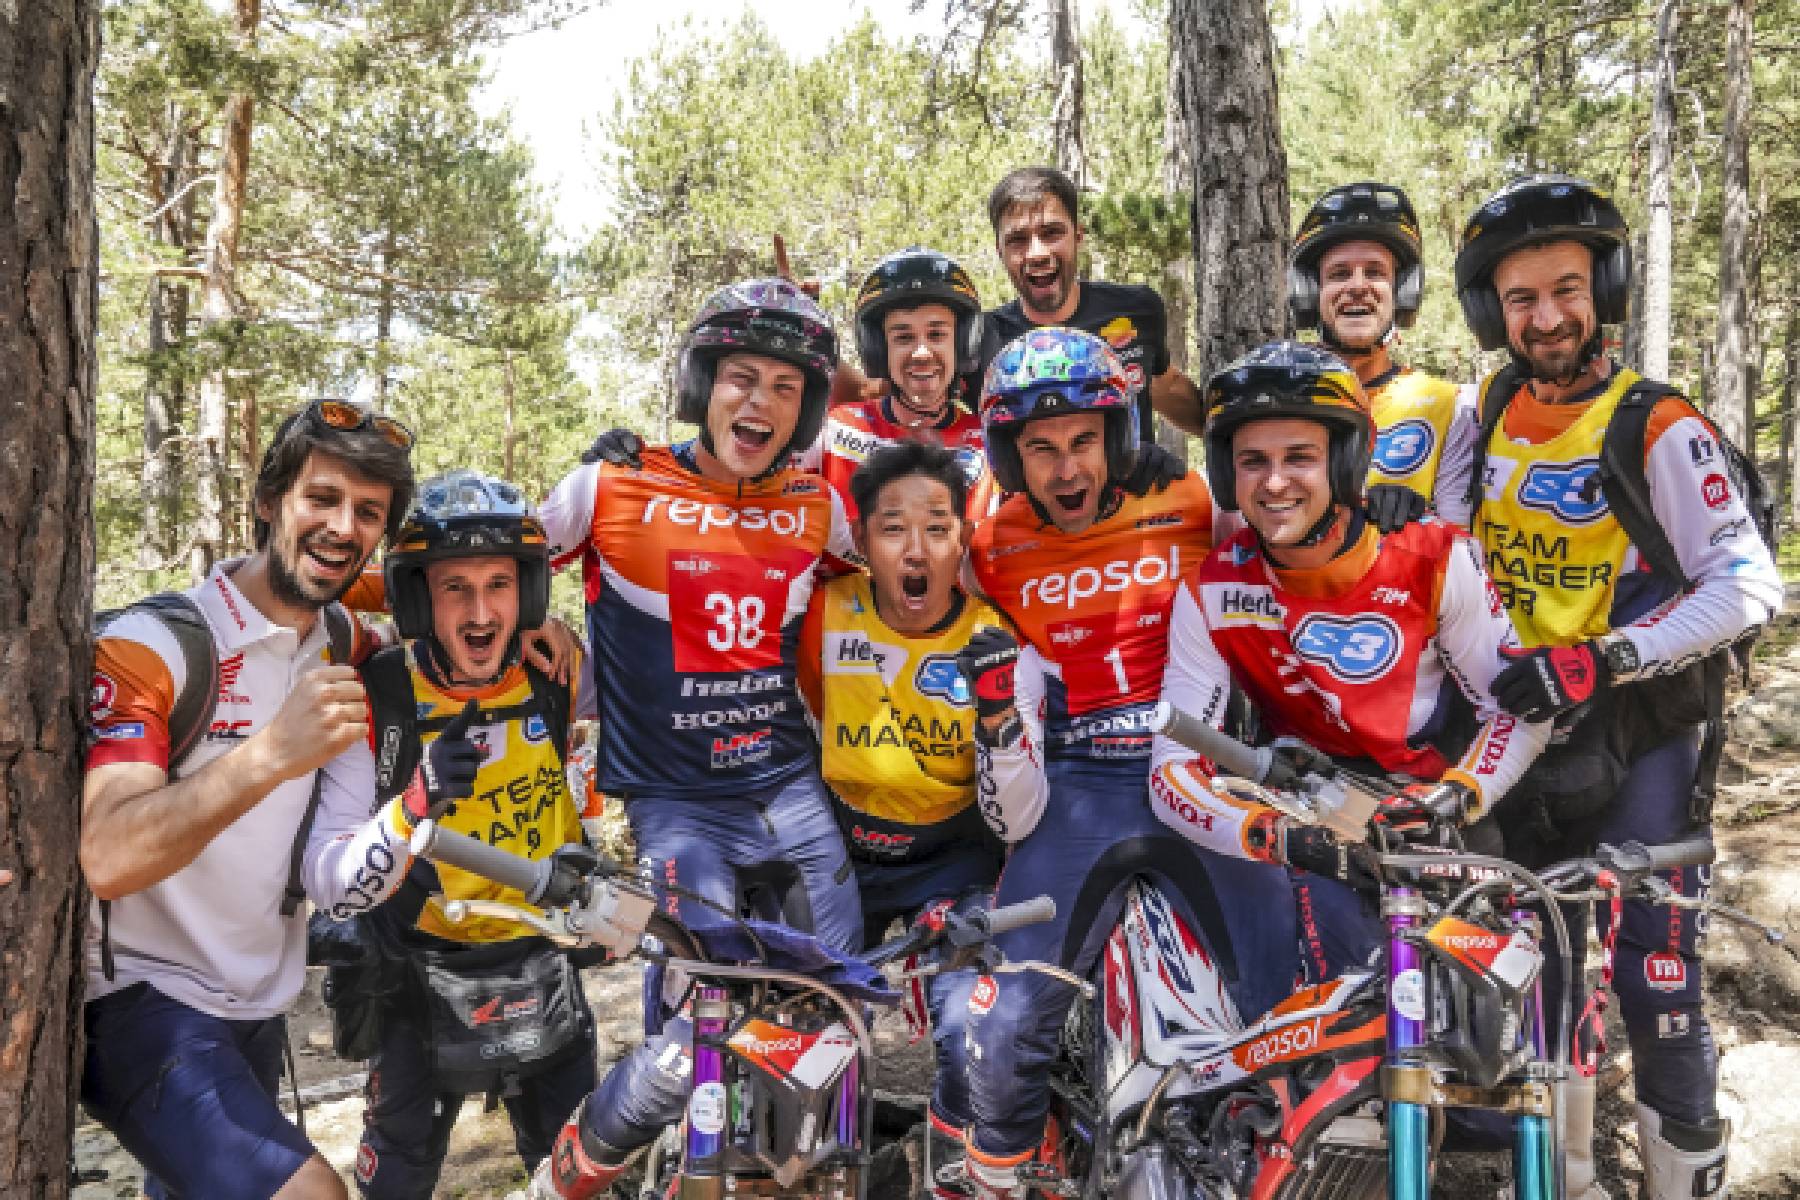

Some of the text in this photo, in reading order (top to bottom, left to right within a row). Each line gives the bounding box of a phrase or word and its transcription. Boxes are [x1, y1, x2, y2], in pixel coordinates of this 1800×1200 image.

[642, 494, 807, 537] repsol
[1020, 543, 1181, 609] repsol
[704, 592, 766, 651] 38
[1103, 647, 1130, 694] 1
